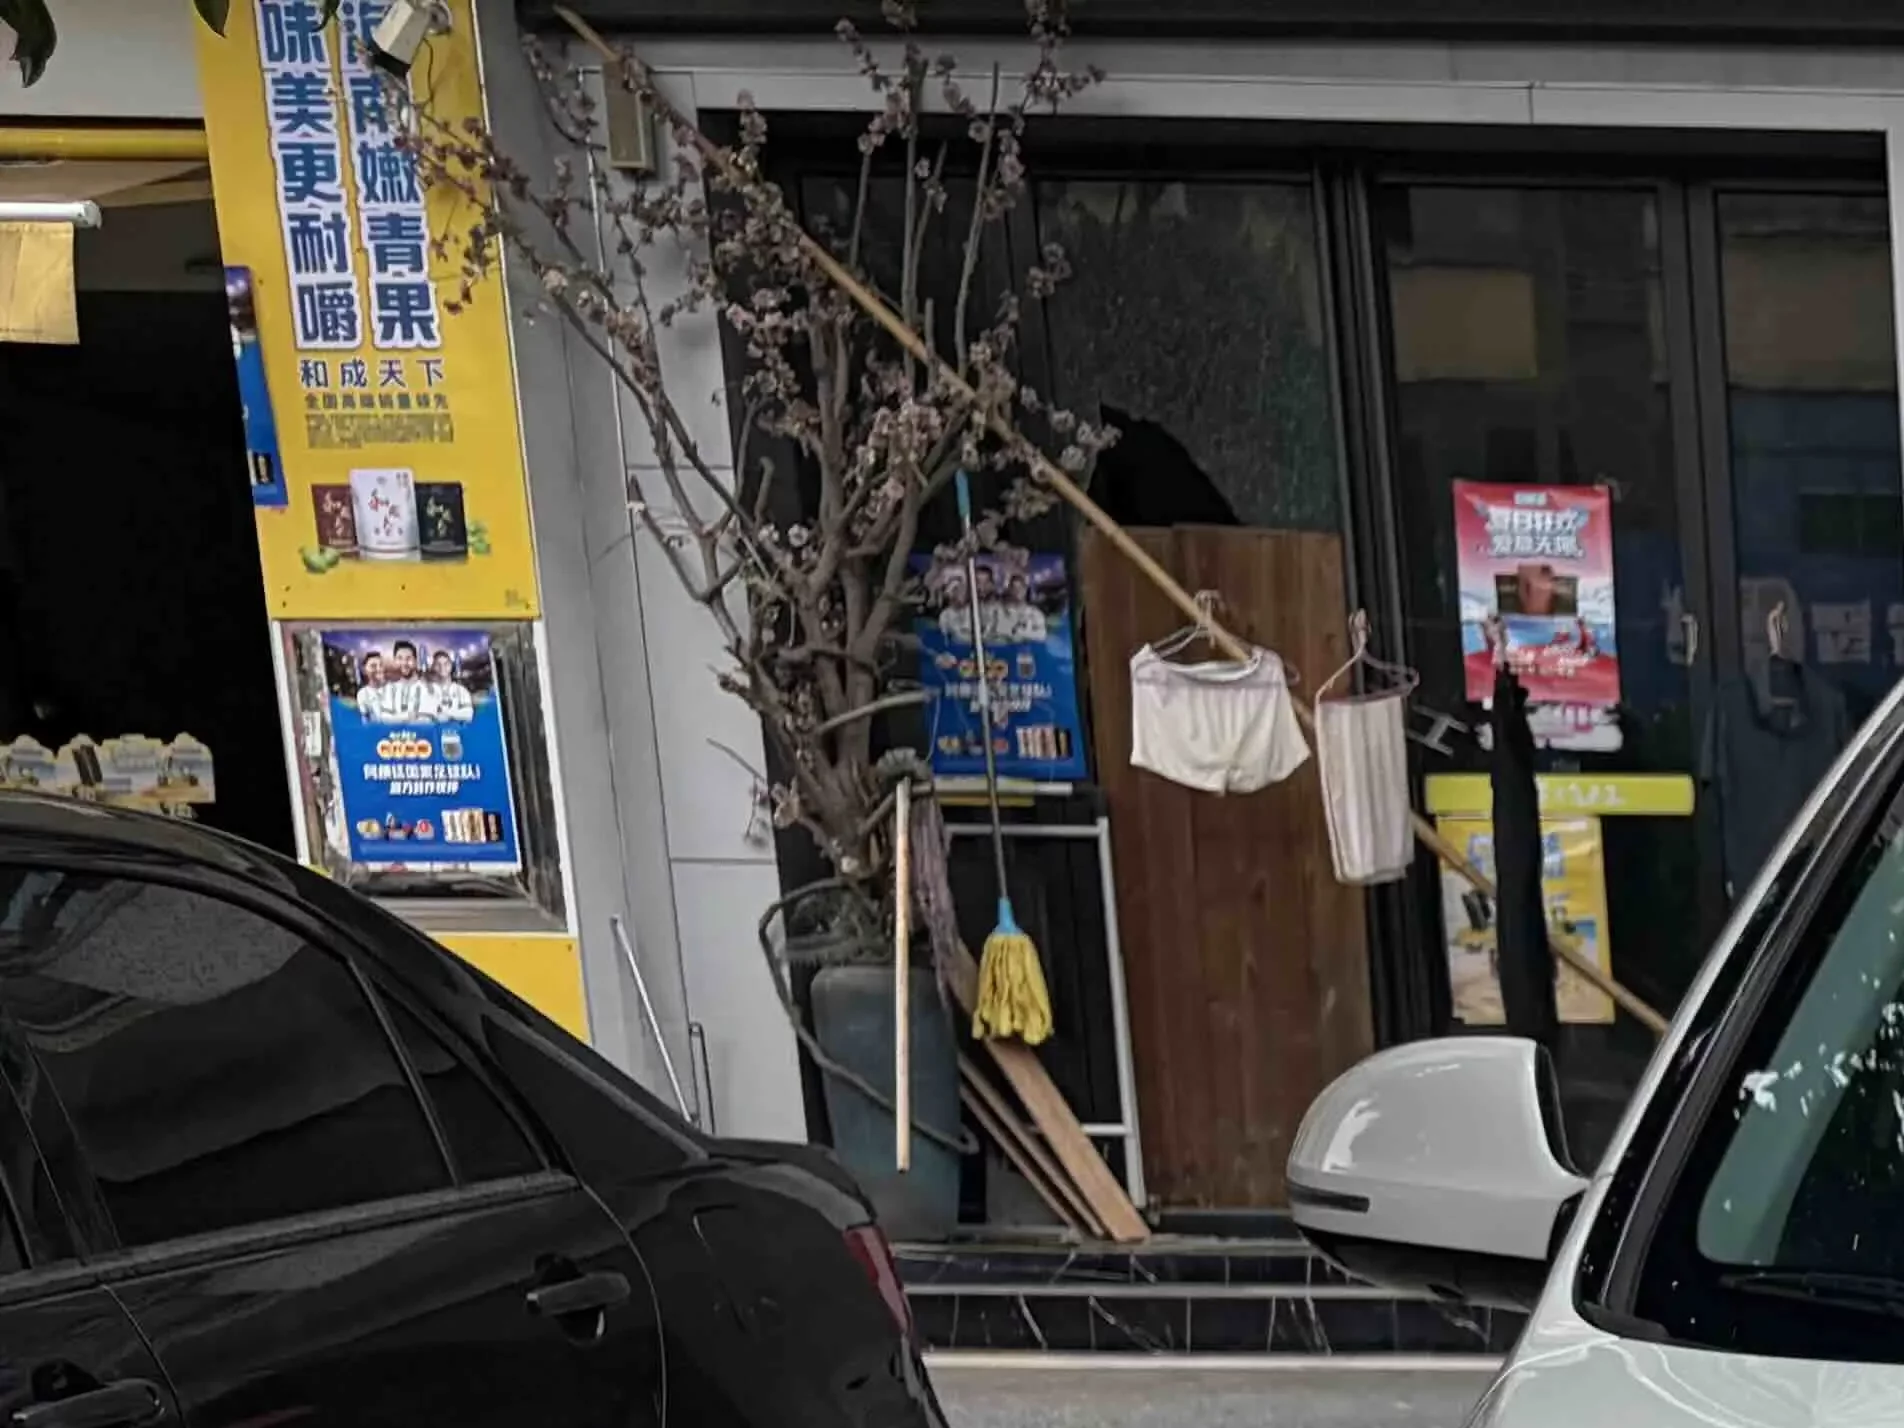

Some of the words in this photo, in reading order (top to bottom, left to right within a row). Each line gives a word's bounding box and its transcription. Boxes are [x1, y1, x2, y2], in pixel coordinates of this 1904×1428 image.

[260, 1, 358, 342] 味美更耐嚼
[300, 357, 444, 389] 和成天下
